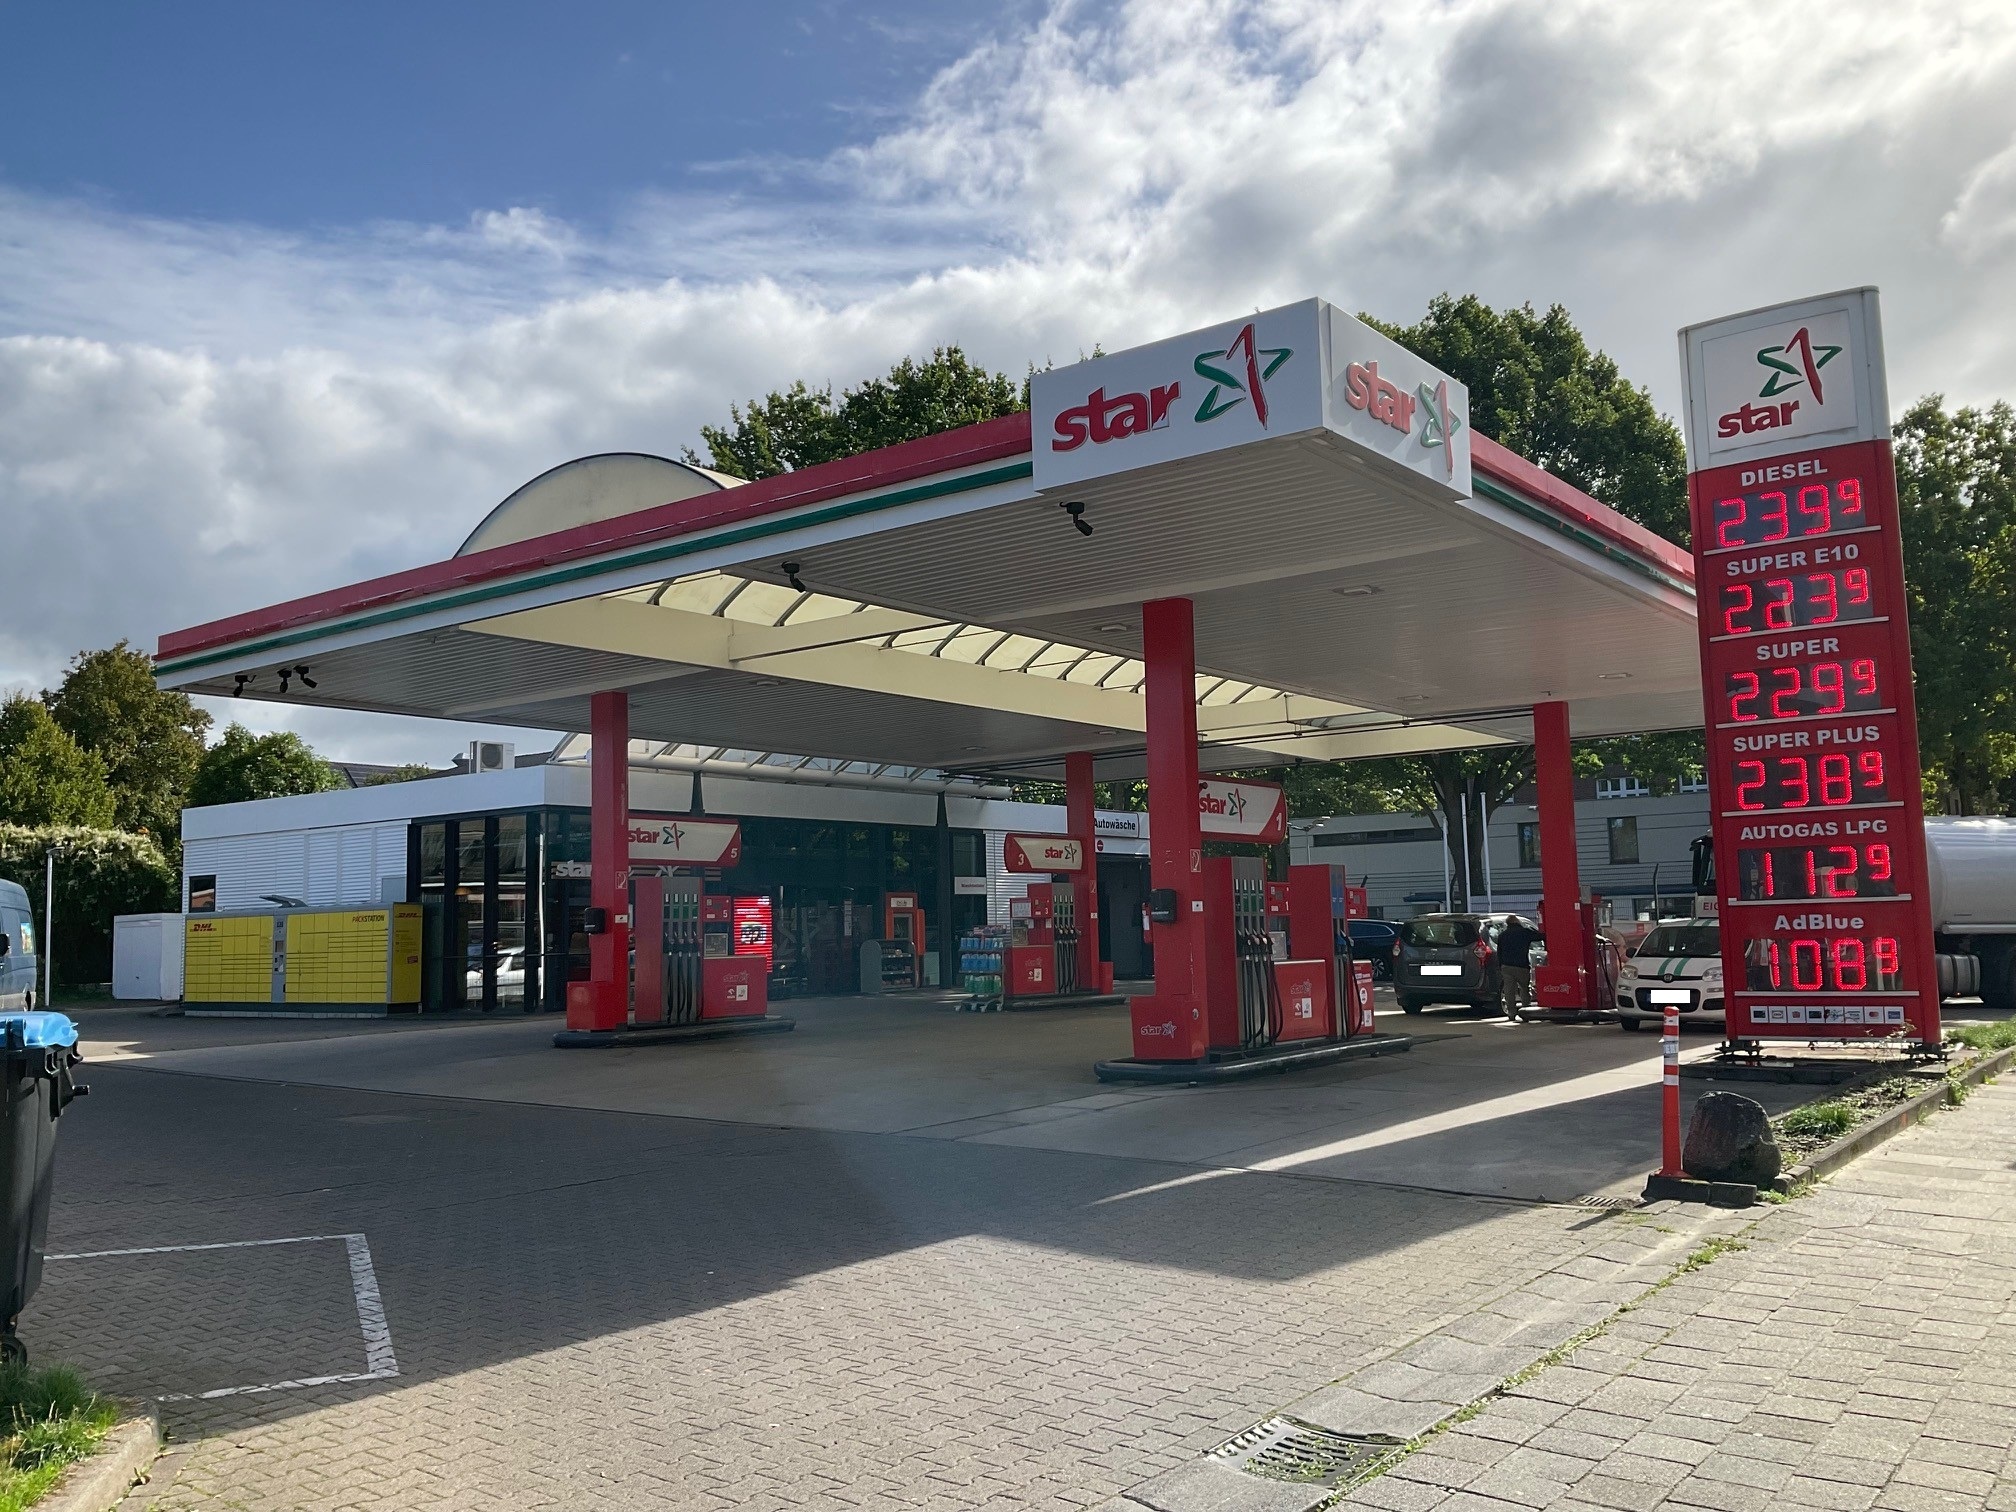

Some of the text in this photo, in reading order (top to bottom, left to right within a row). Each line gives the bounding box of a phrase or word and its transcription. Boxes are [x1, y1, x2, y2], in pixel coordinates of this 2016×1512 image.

[1344, 360, 1416, 435] star
[1052, 380, 1181, 453] star
[1717, 399, 1800, 438] star
[1740, 458, 1828, 487] DIESEL
[1726, 543, 1860, 576] SUPER E10
[1756, 637, 1840, 661] SUPER
[1733, 725, 1880, 752] SUPER PLUS
[1199, 793, 1226, 814] star
[1094, 818, 1136, 830] Autowäsche
[1276, 812, 1283, 831] 1
[1740, 818, 1888, 841] AUTOGAS LPG
[628, 827, 660, 844] star
[730, 847, 738, 859] 5
[1018, 853, 1025, 866] 3
[1044, 846, 1063, 859] star
[352, 914, 386, 923] PACKSTATION
[722, 909, 728, 918] 5
[1774, 913, 1865, 931] AdBlue
[1140, 1024, 1161, 1036] star
